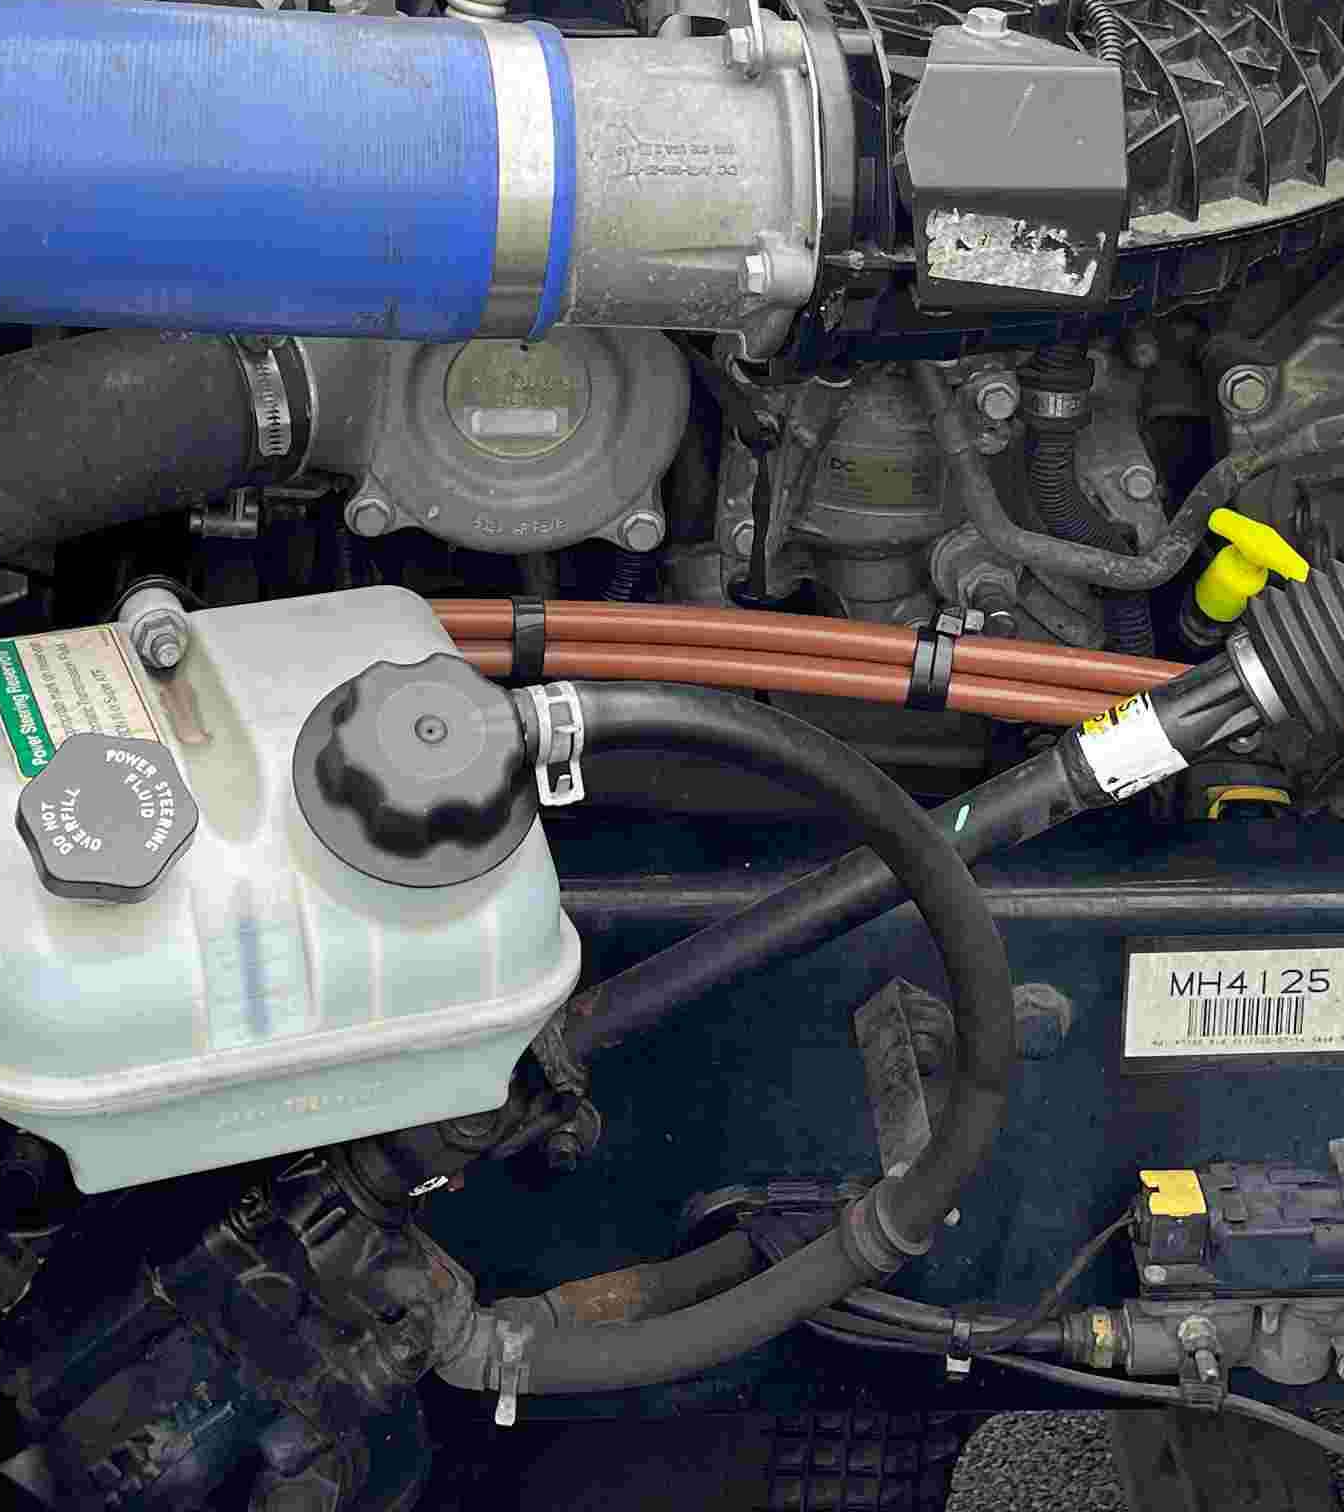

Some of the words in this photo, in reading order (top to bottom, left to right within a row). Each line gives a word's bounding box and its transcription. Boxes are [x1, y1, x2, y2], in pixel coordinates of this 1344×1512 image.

[12, 694, 37, 735] Steering
[28, 735, 49, 767] Power
[41, 801, 58, 832] NOT
[106, 749, 157, 779] POWER
[145, 781, 174, 852] STEERING
[124, 774, 155, 818] FLUID
[60, 788, 102, 852] OVERFILL
[53, 835, 74, 855] DO
